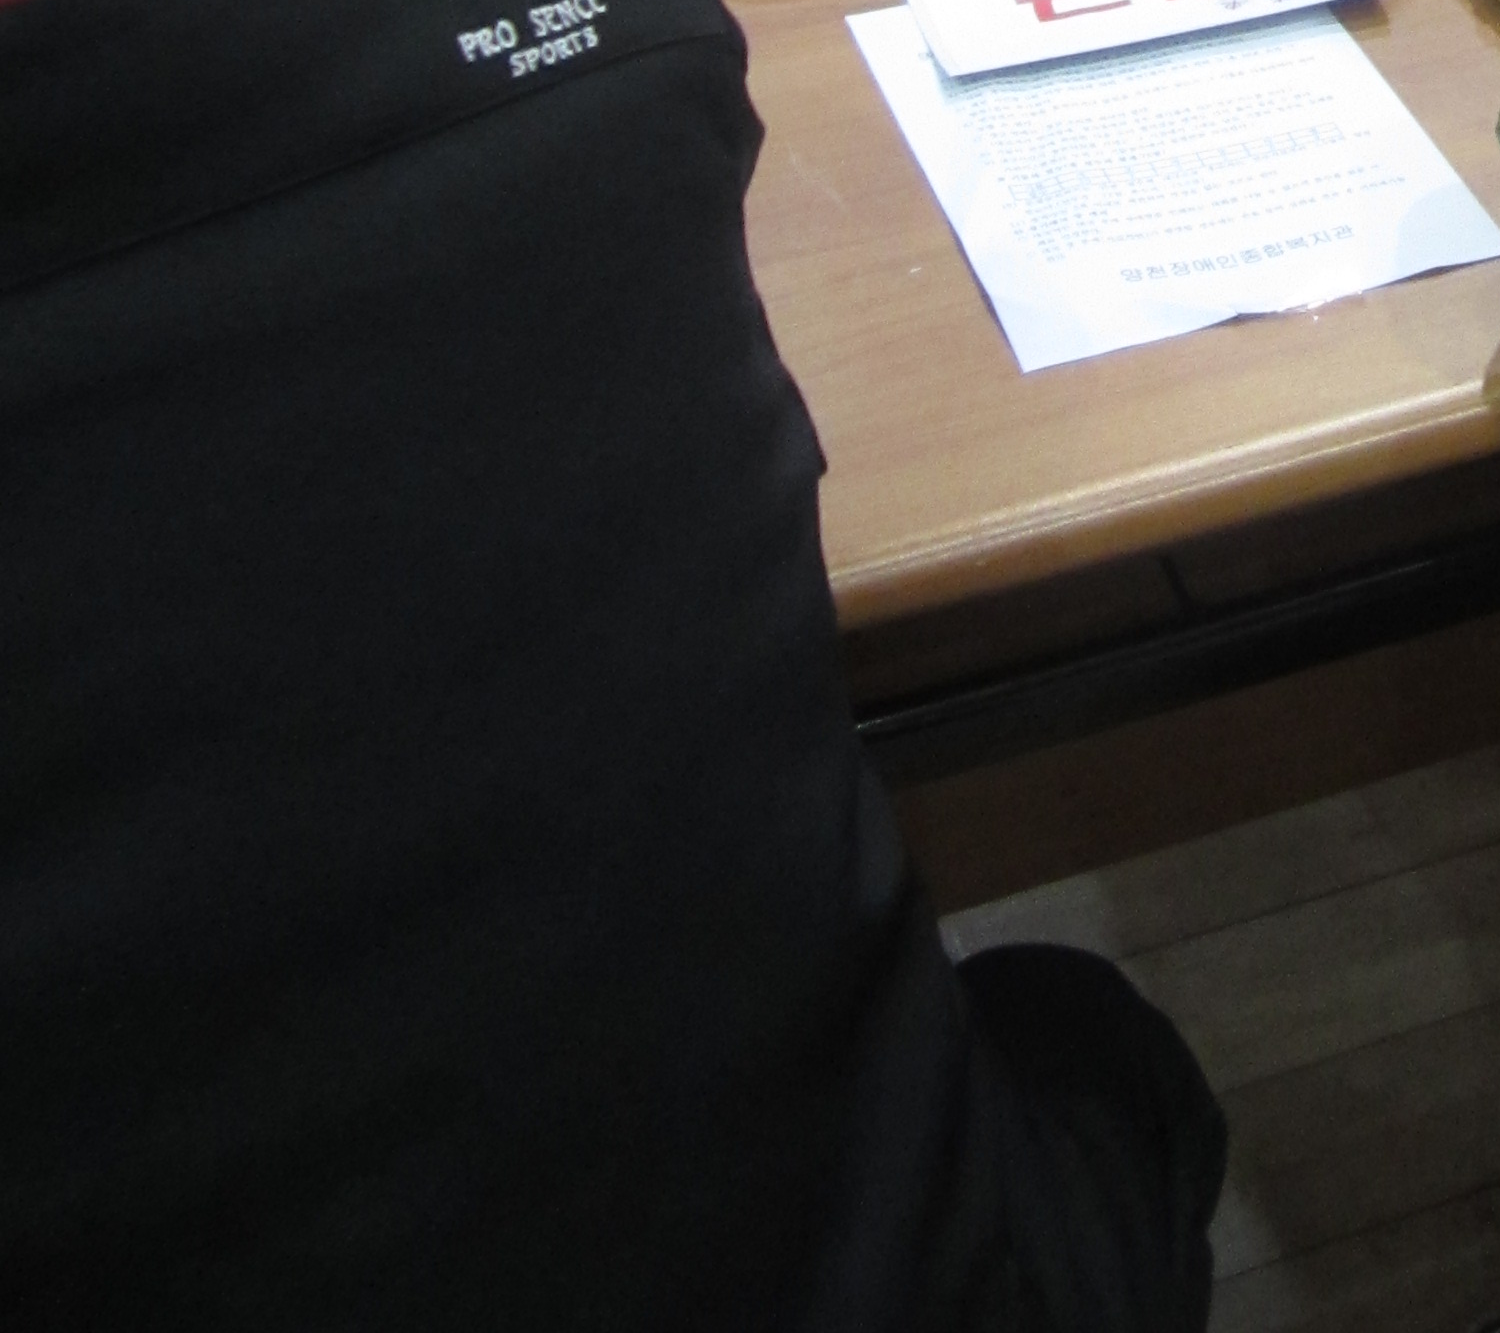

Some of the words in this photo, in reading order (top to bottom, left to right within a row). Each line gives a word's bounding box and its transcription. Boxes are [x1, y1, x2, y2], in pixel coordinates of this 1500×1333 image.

[457, 18, 518, 64] PRO
[508, 25, 600, 78] SPORTS
[1120, 223, 1355, 283] 양천장애인종합복지관
